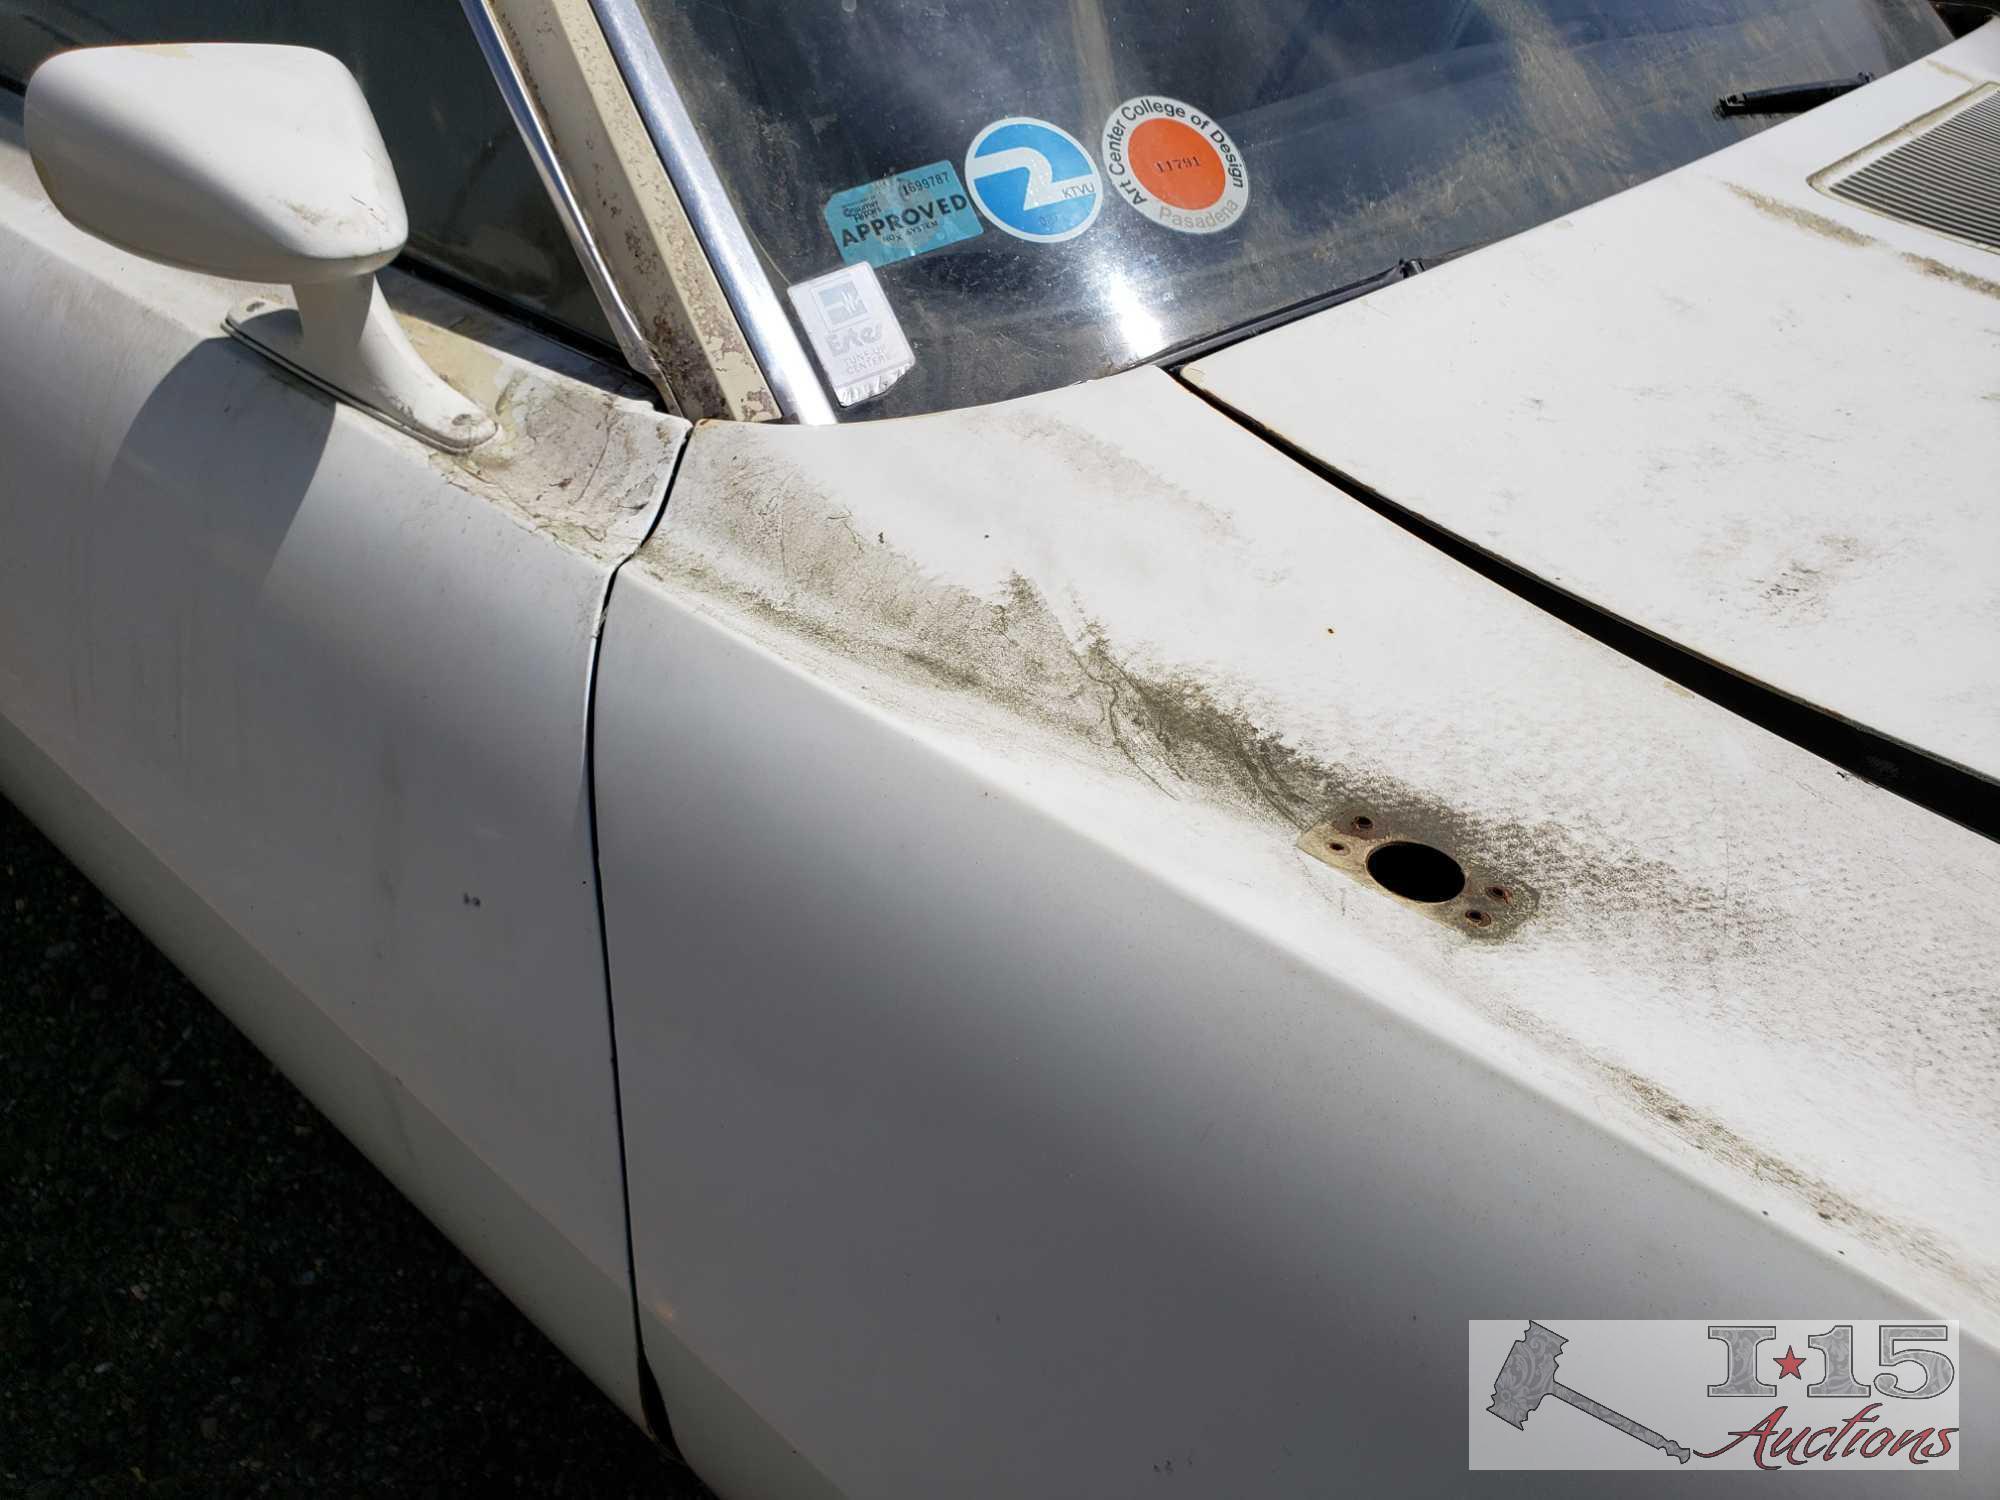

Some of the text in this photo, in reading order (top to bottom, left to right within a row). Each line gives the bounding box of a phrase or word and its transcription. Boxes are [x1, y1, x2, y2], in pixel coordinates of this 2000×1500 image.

[1107, 99, 1244, 206] Art Center College of Design
[1062, 183, 1095, 199] KTVU
[841, 194, 967, 247] APPROVED
[1159, 199, 1239, 229] Pasadena
